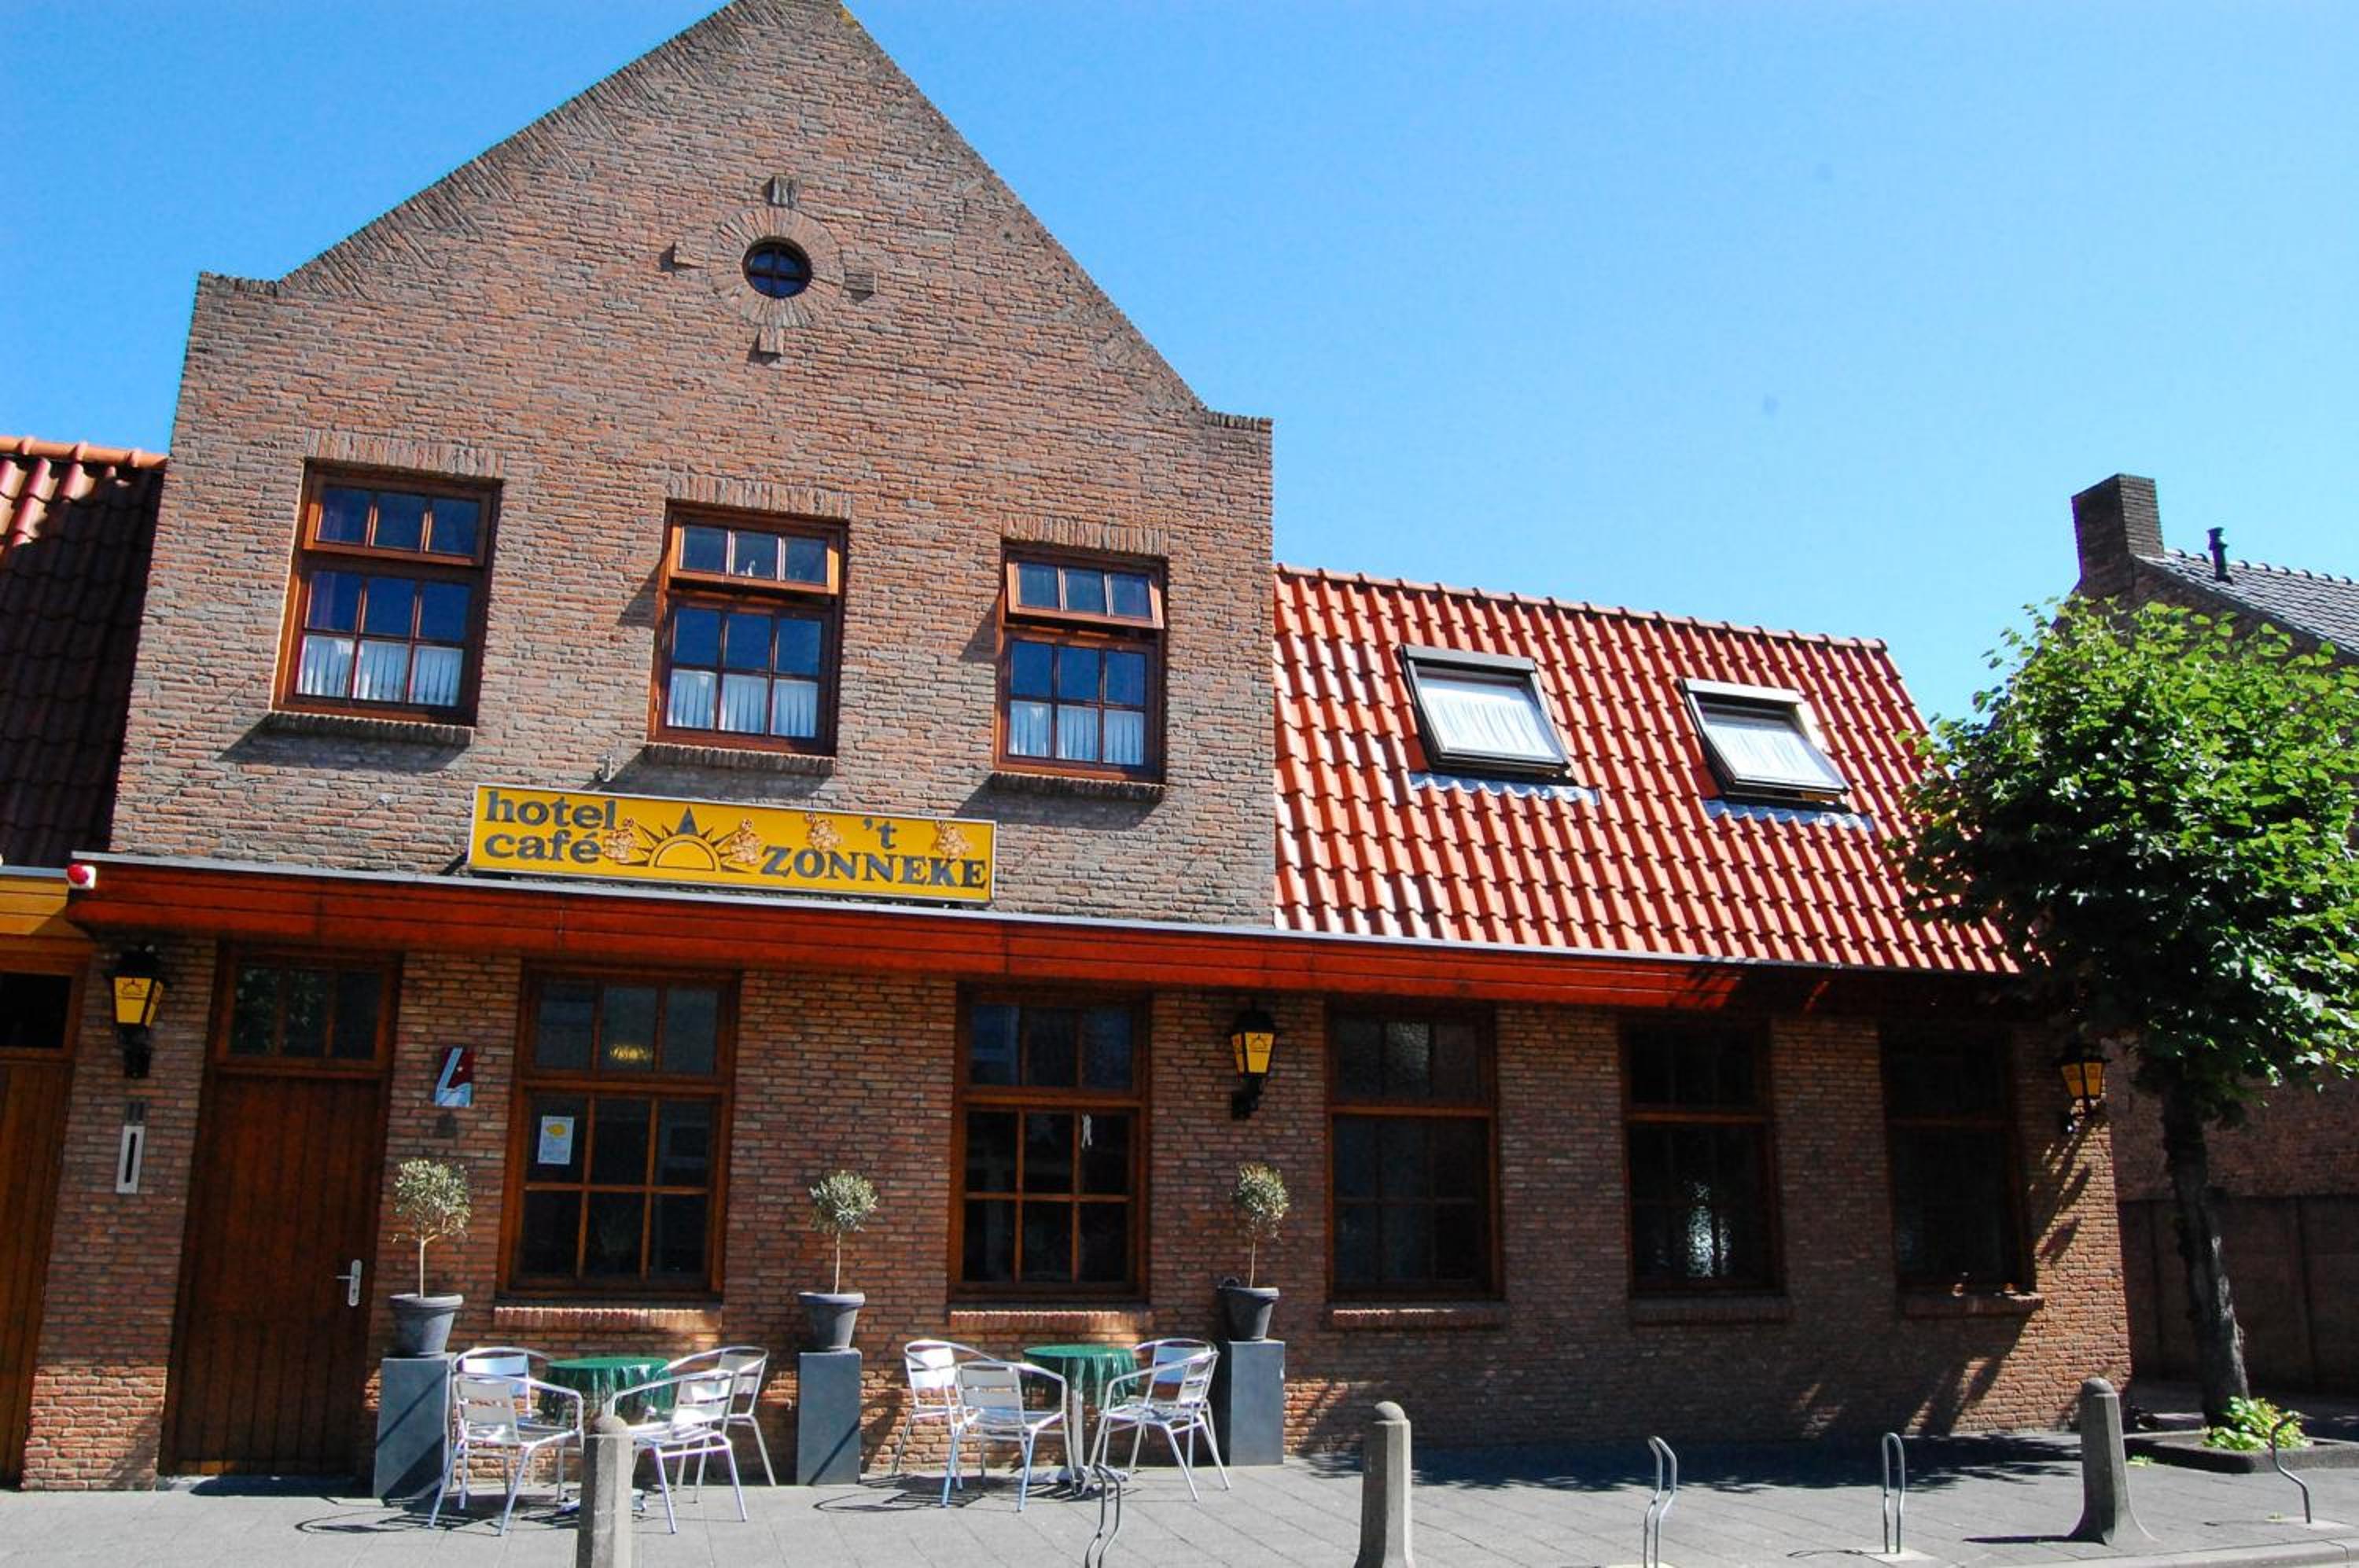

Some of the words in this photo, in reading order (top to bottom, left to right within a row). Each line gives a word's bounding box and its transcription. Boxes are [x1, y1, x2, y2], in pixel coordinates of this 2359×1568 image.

[484, 791, 616, 830] hotel
[484, 829, 602, 863] café
[863, 817, 898, 849] 't
[760, 845, 987, 889] ZONNEKE
